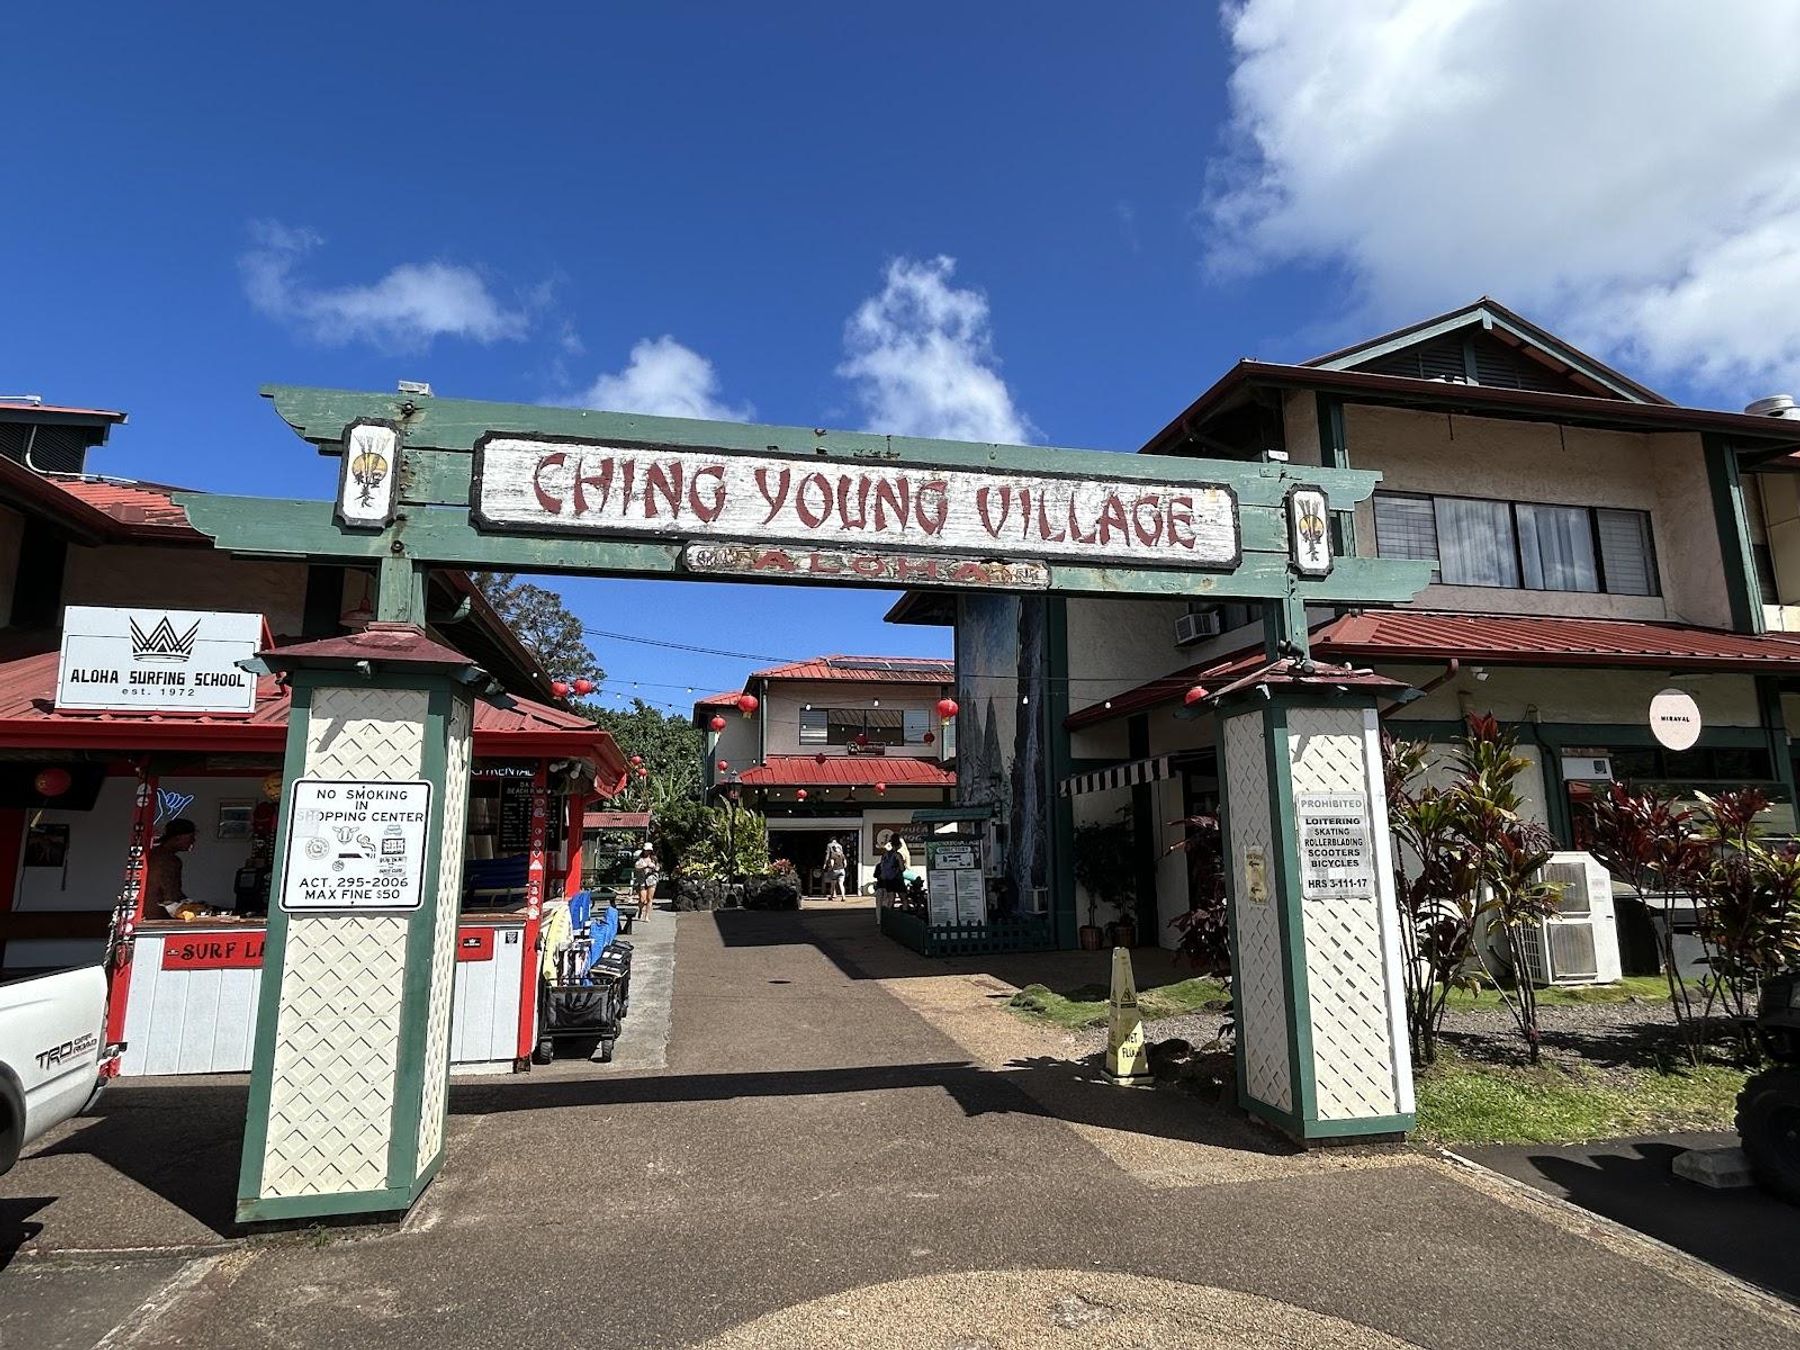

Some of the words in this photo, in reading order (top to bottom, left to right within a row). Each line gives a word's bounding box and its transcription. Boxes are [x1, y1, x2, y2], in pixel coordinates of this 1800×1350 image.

[533, 452, 727, 523] CHING
[754, 467, 949, 538] YOUNG
[976, 485, 1197, 549] VILLAGE
[754, 551, 991, 583] ALOHA
[70, 668, 119, 684] ALOHA
[129, 670, 185, 686] SURFING
[194, 672, 246, 688] SCHOOL
[121, 687, 151, 696] est.
[160, 688, 195, 697] 1972
[316, 789, 337, 799] NO
[346, 790, 408, 800] SMOKING
[355, 801, 369, 810] IN
[1301, 800, 1362, 808] PROHIBITED
[371, 812, 424, 822] CENTER
[1305, 839, 1363, 847] ROLLERBLADING
[1308, 849, 1360, 857] SCOOTERS
[1311, 859, 1359, 867] BICYCLES
[299, 877, 332, 888] ACT.
[337, 877, 409, 888] 295-2006
[1308, 879, 1328, 889] HRS
[1329, 878, 1368, 889] 3-111-17
[304, 889, 337, 900] MAX
[341, 889, 373, 899] FINE
[376, 889, 400, 899] $50
[180, 941, 237, 961] SURF
[35, 1040, 73, 1071] TRD
